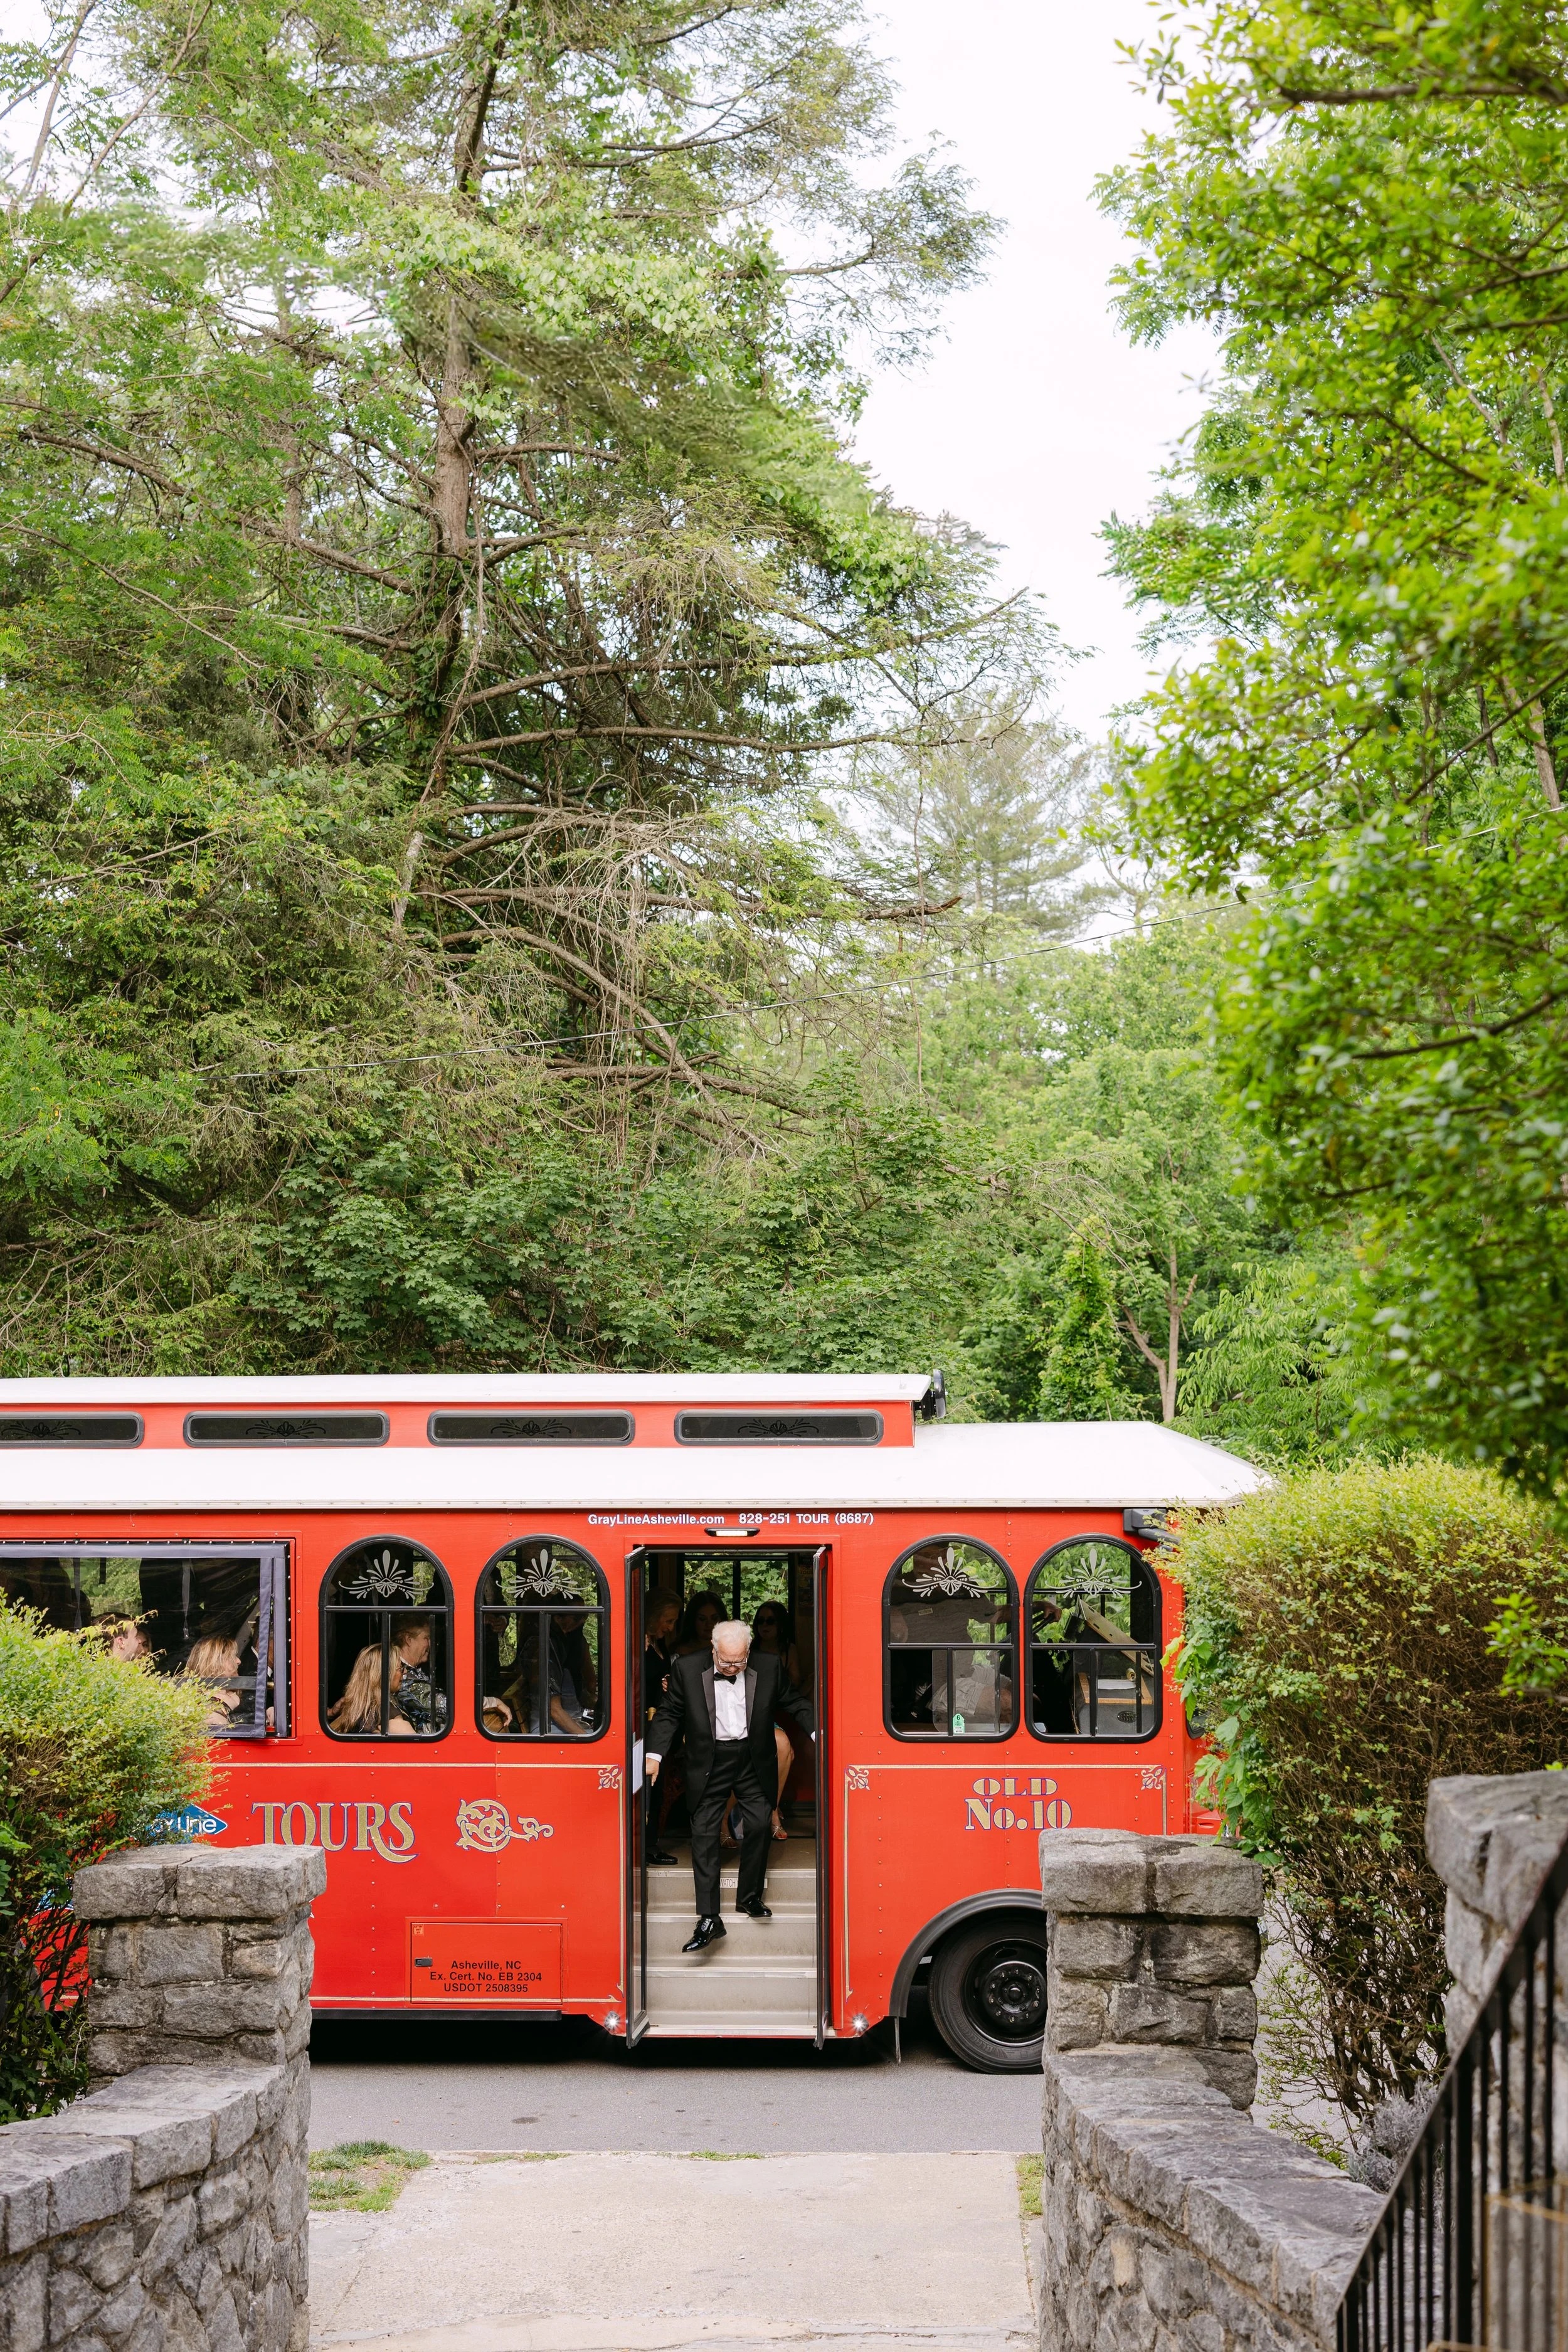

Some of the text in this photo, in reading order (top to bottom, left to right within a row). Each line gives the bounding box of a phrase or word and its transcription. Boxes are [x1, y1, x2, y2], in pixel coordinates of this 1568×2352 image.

[588, 1513, 874, 1527] GrayLineAsheville.com 828-251 TOUR (8687)
[972, 1778, 1058, 1796] OLD
[252, 1802, 418, 1863] TOURS
[451, 1961, 521, 1971] Asheville, NC
[430, 1972, 543, 1981] Ex. Cert. No. EB 2304
[443, 1983, 528, 1993] USDOT 2508395
